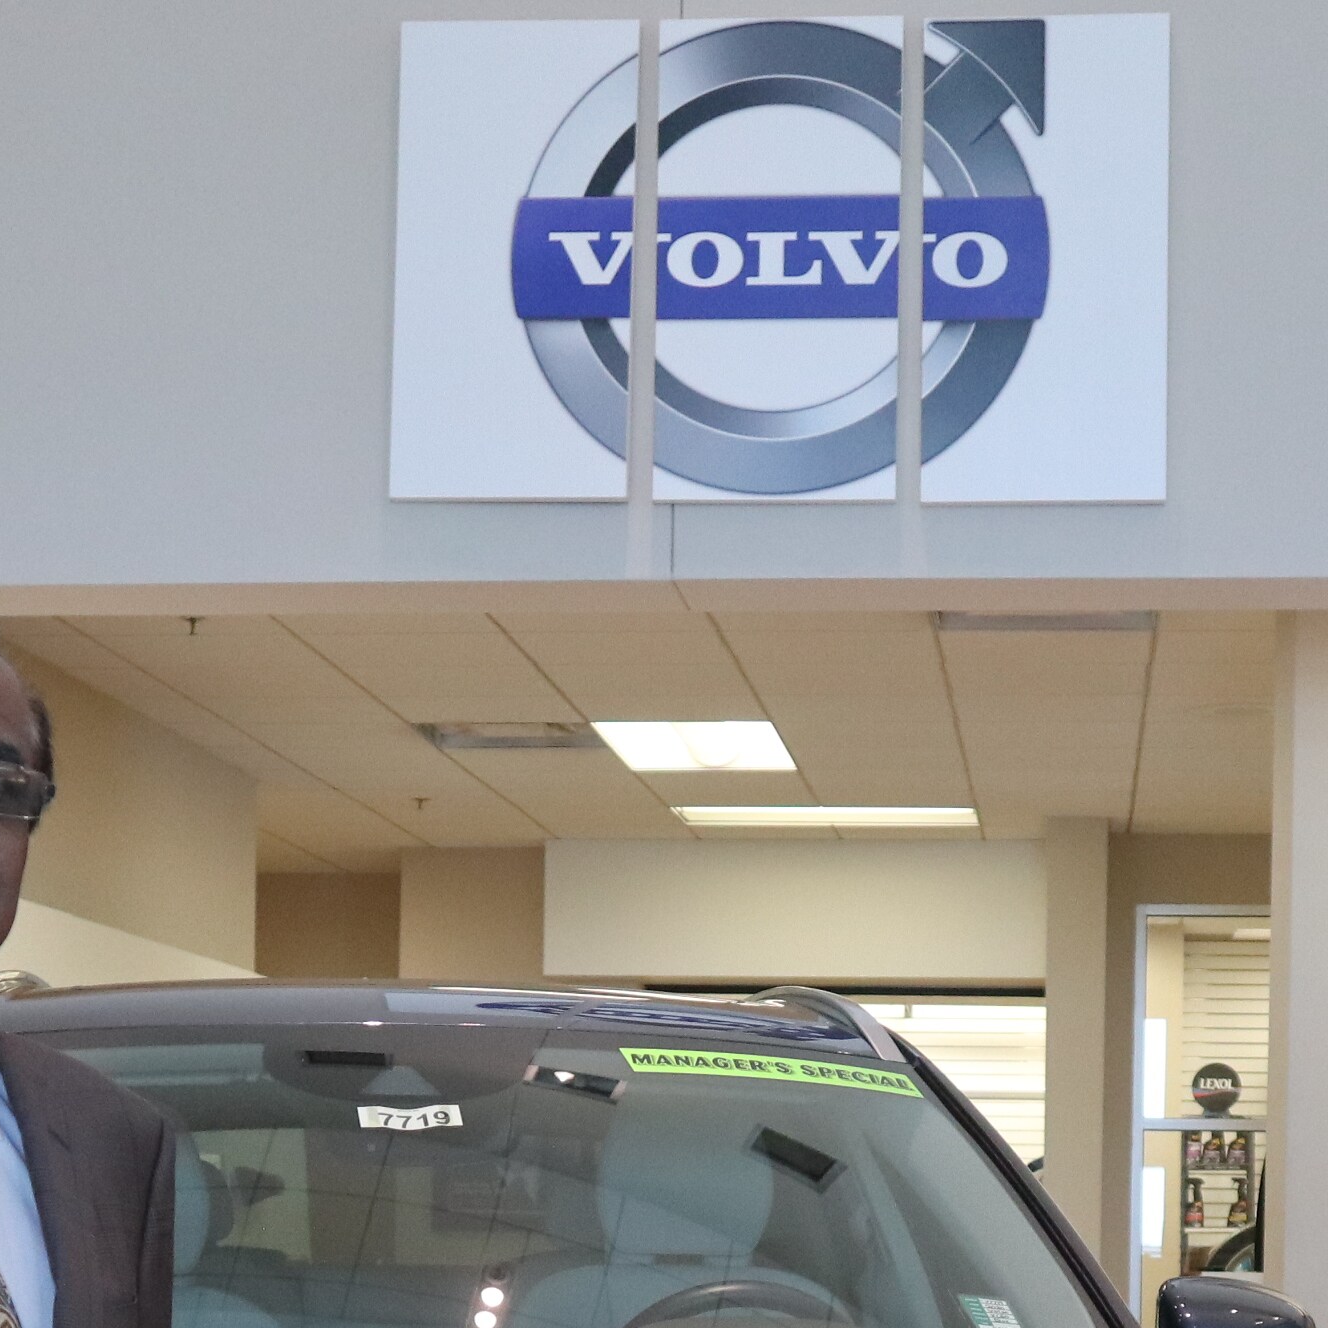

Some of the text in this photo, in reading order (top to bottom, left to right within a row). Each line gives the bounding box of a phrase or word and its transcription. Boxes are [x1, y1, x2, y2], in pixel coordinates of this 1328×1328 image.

[548, 230, 1009, 289] VOLVO
[630, 1052, 912, 1090] MANAGER'S SPECIAL
[1199, 1077, 1235, 1091] LEXOL
[377, 1110, 451, 1129] 7719
